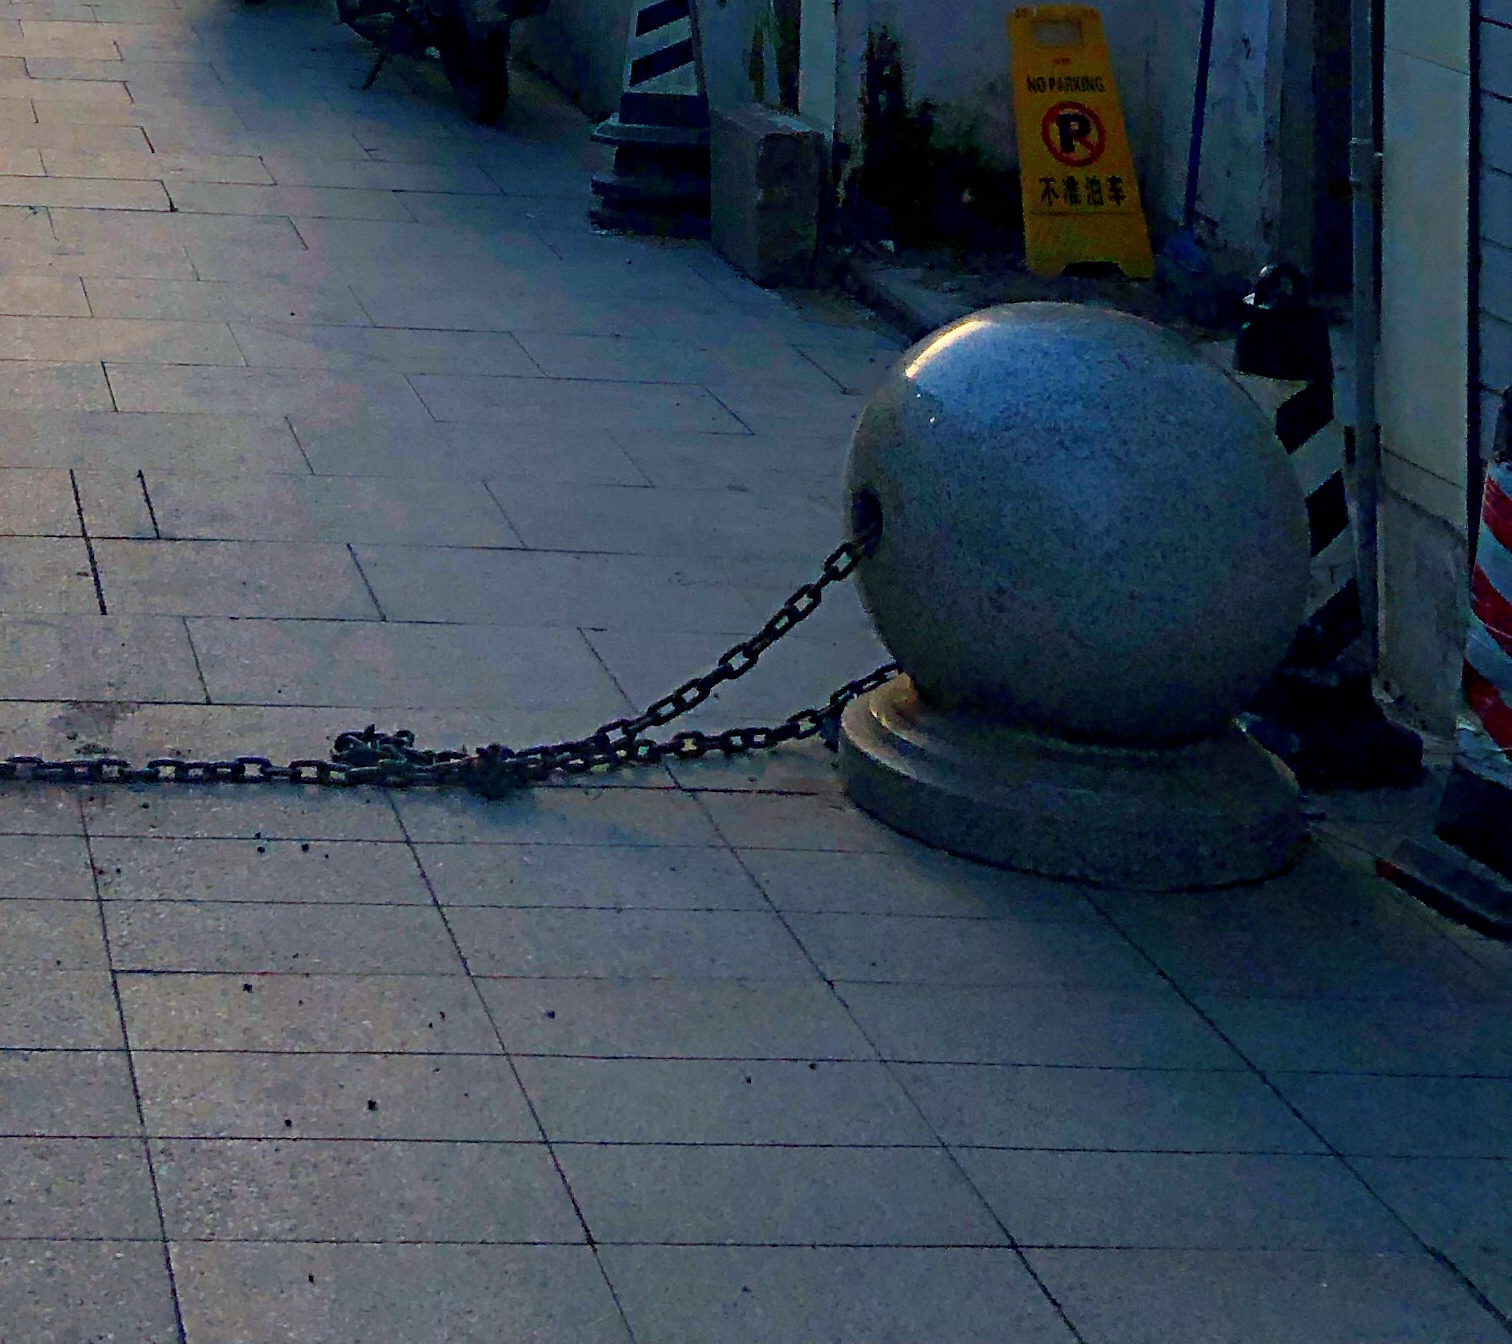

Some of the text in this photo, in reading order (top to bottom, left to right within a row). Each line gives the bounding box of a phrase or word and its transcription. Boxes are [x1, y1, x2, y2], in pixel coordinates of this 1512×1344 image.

[1026, 74, 1105, 93] NO PARKING
[1057, 113, 1091, 153] P
